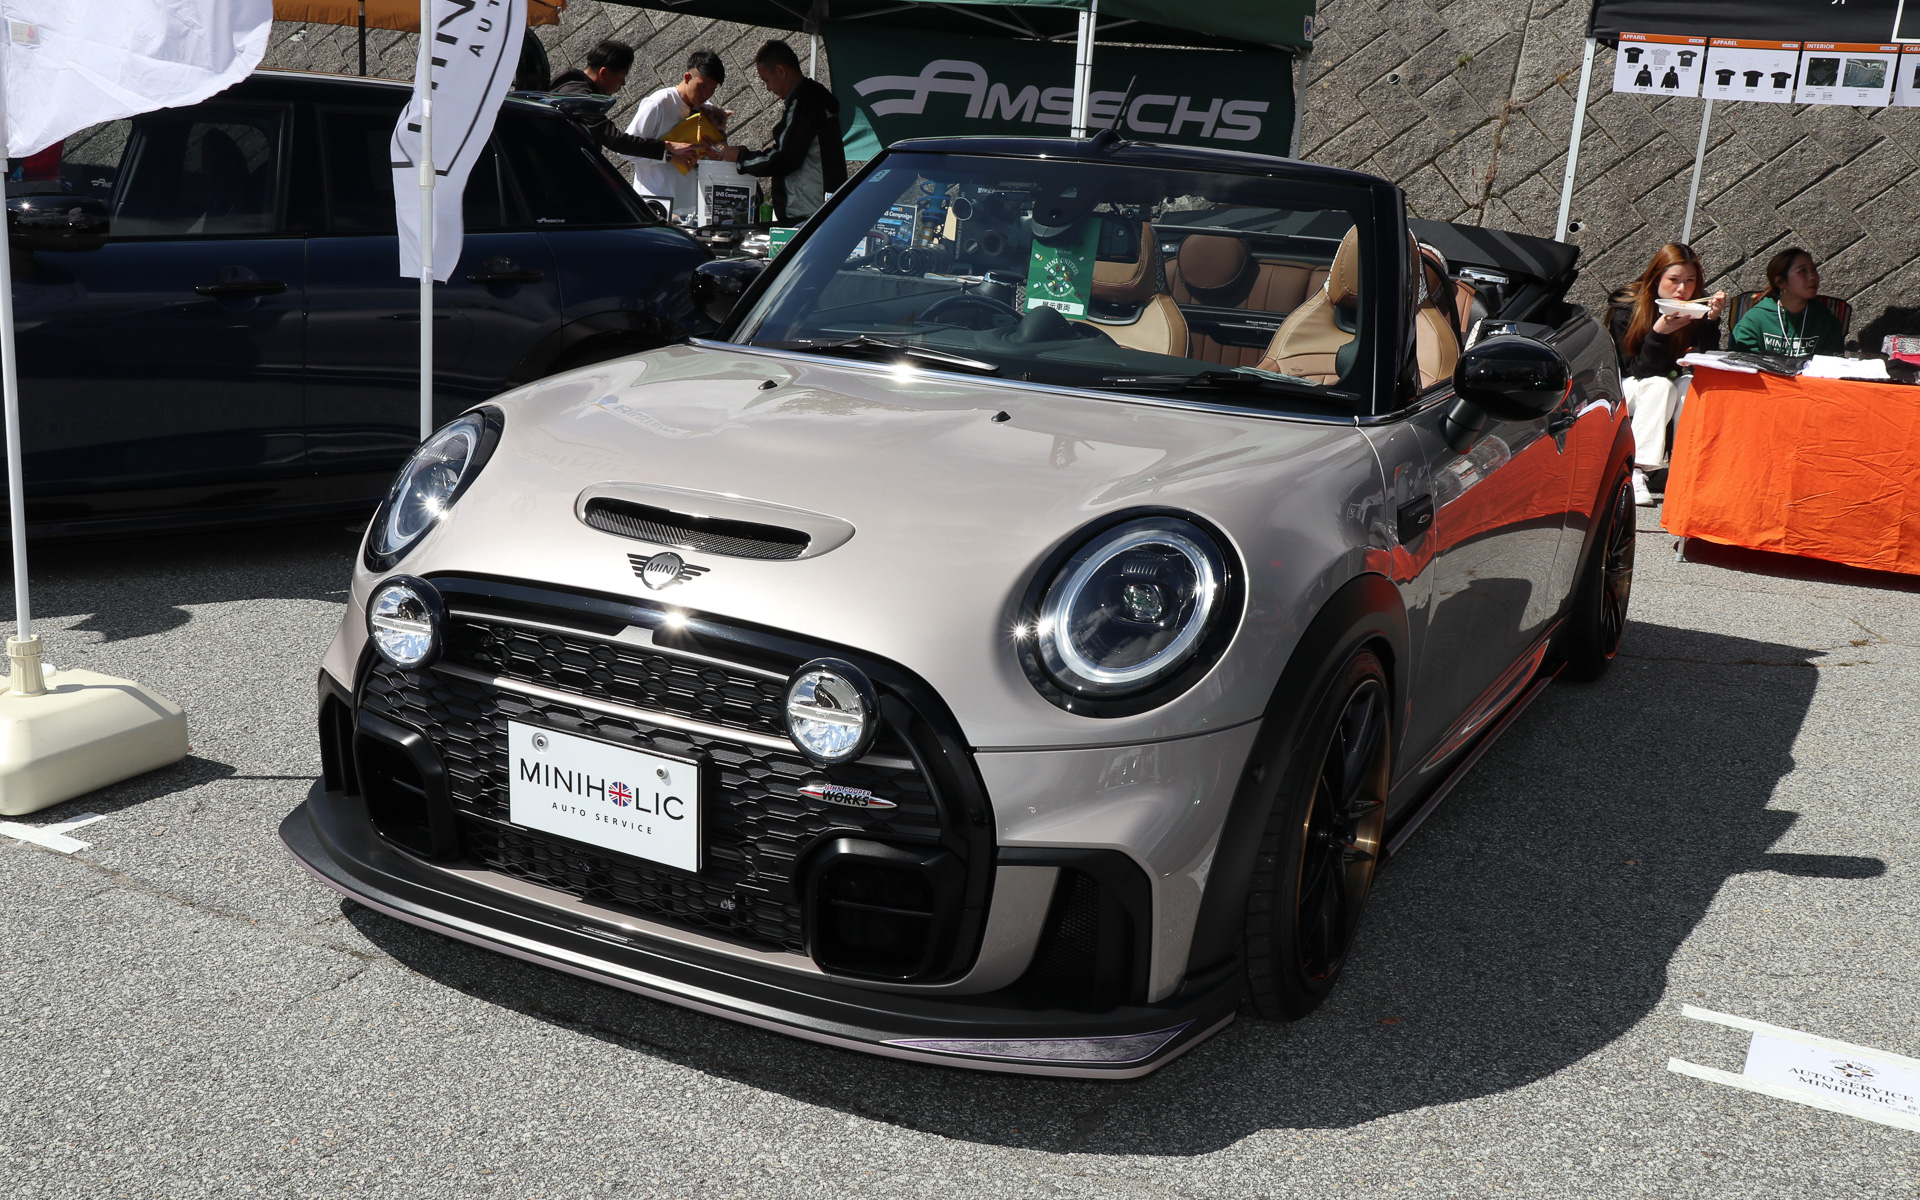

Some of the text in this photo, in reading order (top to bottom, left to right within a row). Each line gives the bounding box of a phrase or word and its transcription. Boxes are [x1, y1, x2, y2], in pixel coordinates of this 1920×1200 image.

[724, 192, 748, 200] Campaign
[890, 211, 913, 220] Campaign
[1044, 257, 1079, 276] MINI UNITED
[646, 562, 677, 576] MINI
[520, 758, 685, 821] MINIHOLIC
[822, 790, 870, 807] WORKS
[844, 786, 872, 797] COOPER
[552, 802, 653, 835] AUTO SERVICE
[1789, 1067, 1914, 1103] AUTO SERVICE
[1798, 1076, 1896, 1106] MINIHOLIC
